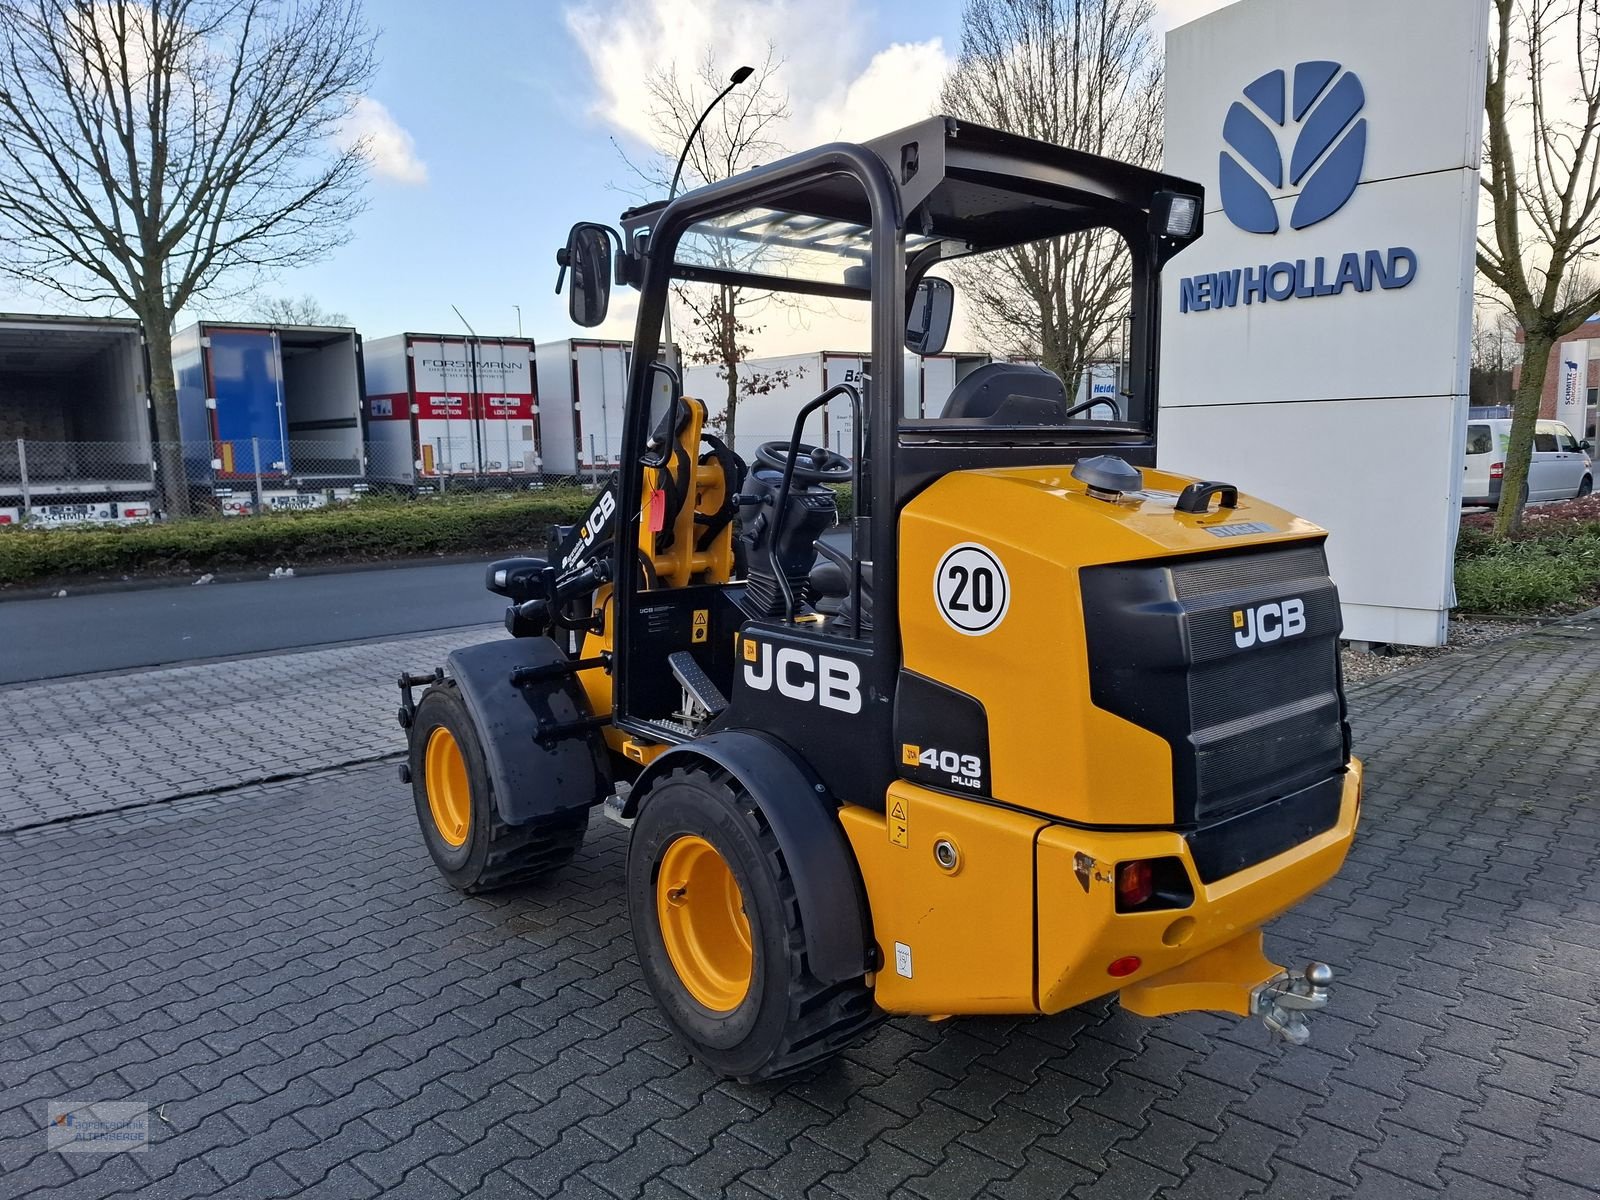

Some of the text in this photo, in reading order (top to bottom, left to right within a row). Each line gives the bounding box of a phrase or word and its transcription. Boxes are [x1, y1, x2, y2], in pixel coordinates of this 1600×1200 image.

[1180, 247, 1417, 313] NEW HOLLAND
[423, 360, 522, 369] FORSTMANN
[584, 491, 616, 546] JCB
[948, 565, 993, 613] 20
[1235, 599, 1306, 648] JCB
[744, 643, 862, 714] JCB
[919, 748, 982, 778] 403
[951, 775, 981, 789] PLUS
